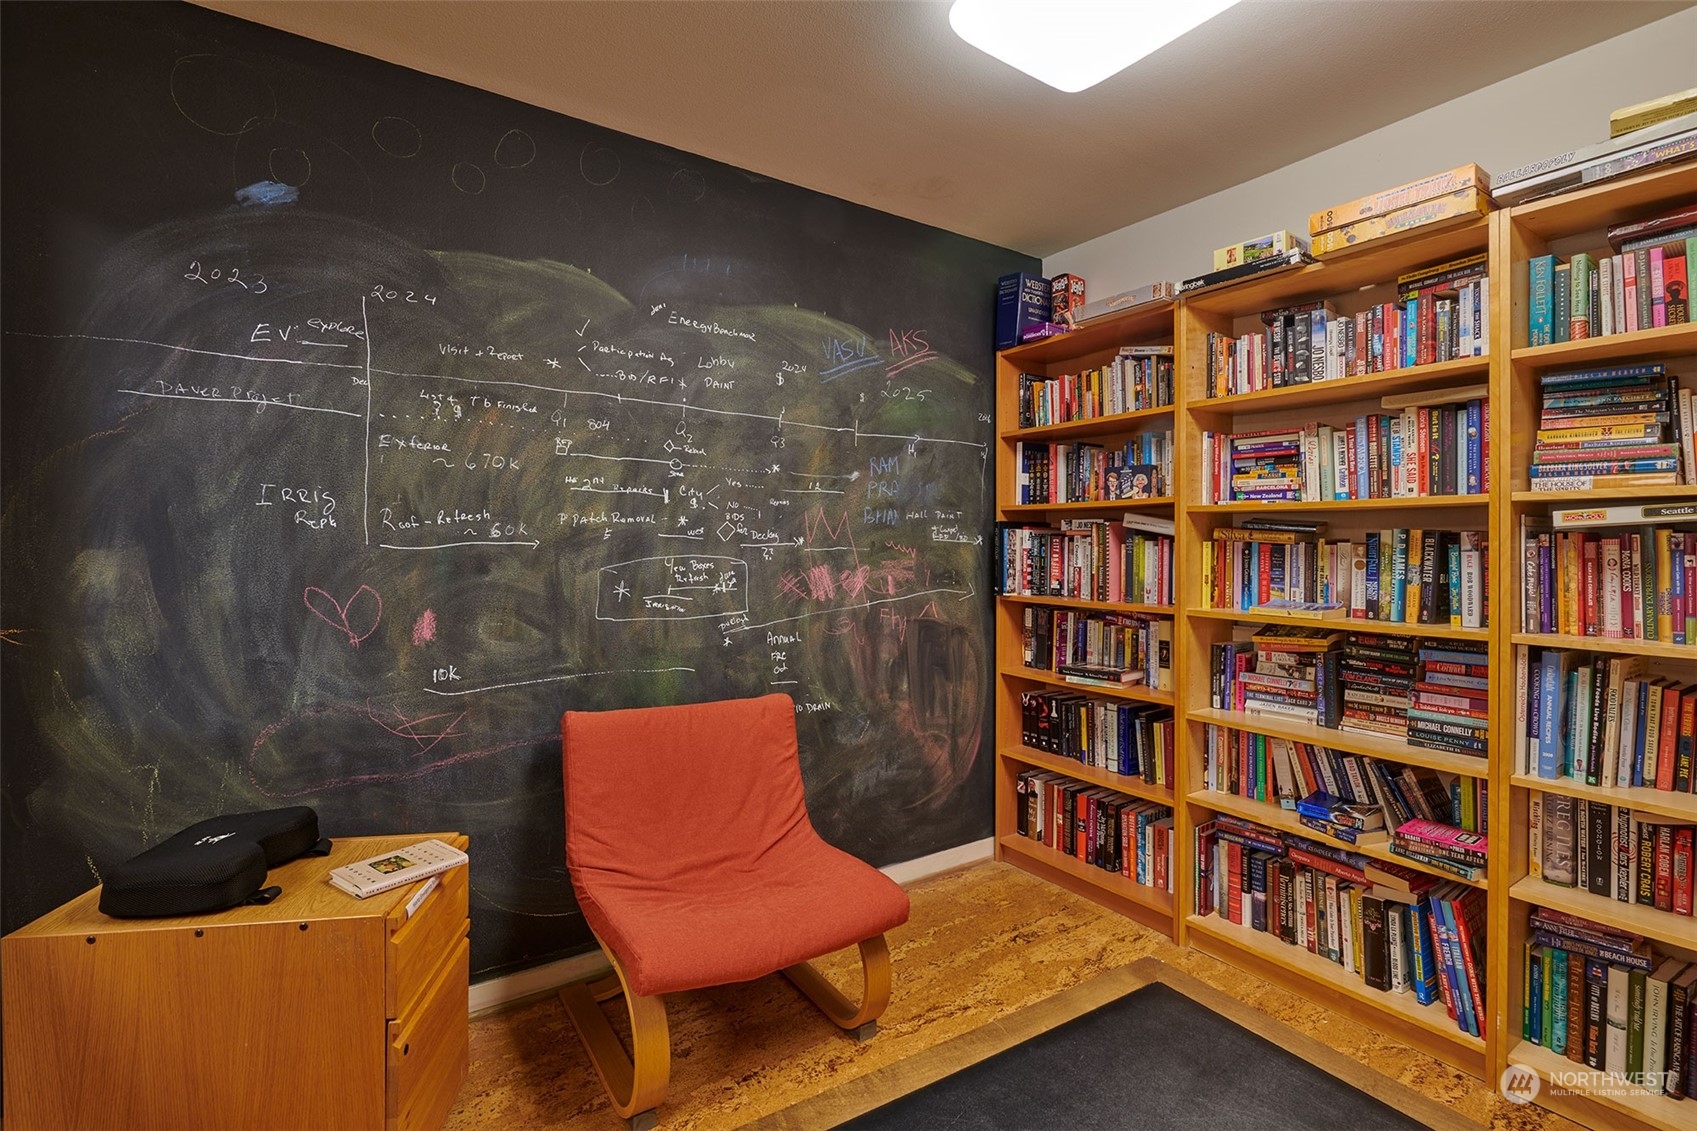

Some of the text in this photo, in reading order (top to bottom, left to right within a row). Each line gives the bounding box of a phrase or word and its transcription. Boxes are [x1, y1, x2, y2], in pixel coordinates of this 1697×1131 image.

[184, 260, 268, 294] 2023
[370, 285, 437, 306] 2024
[1535, 281, 1546, 314] FOLLETT
[822, 336, 866, 364] VASU
[889, 328, 930, 358] AKS
[880, 380, 932, 402] 2025
[1396, 553, 1406, 580] JAMES
[1422, 538, 1435, 583] BLACKWATER
[1466, 585, 1474, 617] WOODWARD
[1416, 733, 1470, 746] LOUISE PENNY
[1417, 721, 1473, 737] MICHAEL CONNELLY
[1659, 827, 1671, 877] HARLAN COBEN
[1605, 951, 1648, 968] BEACH HOUSE
